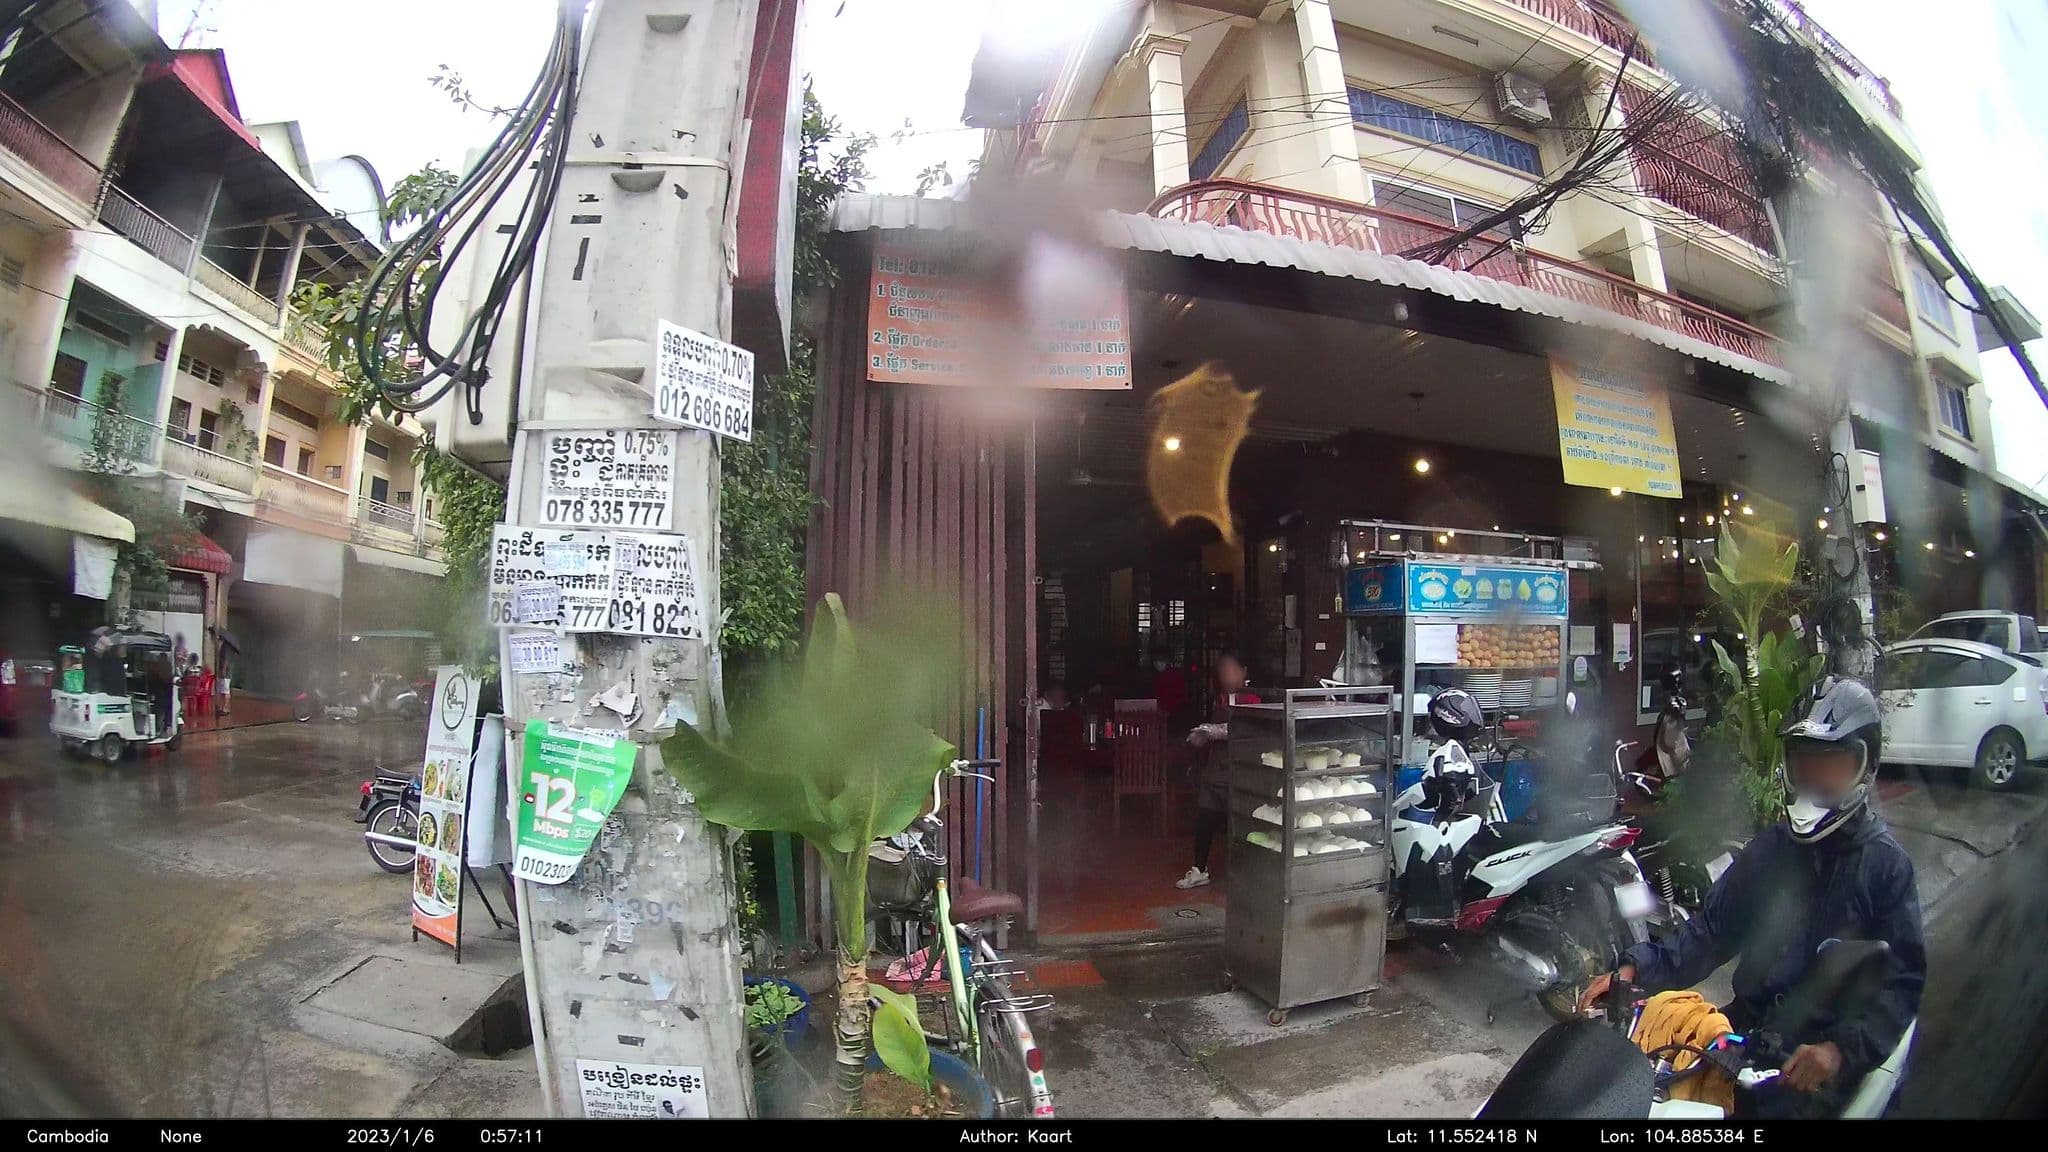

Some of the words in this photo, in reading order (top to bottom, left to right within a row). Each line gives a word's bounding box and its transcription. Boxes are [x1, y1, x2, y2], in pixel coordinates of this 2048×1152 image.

[660, 385, 690, 420] 012
[694, 396, 721, 429] 686
[724, 405, 749, 438] 684
[624, 431, 669, 457] 0.75%
[547, 499, 584, 523] 078
[589, 499, 623, 525] 335
[629, 501, 666, 526] 777
[490, 600, 521, 625] 06
[571, 605, 607, 628] 777
[531, 772, 576, 824] 12
[533, 818, 570, 839] Mbps
[583, 1065, 701, 1094] បង្រៀនដល់ផ្ទះ
